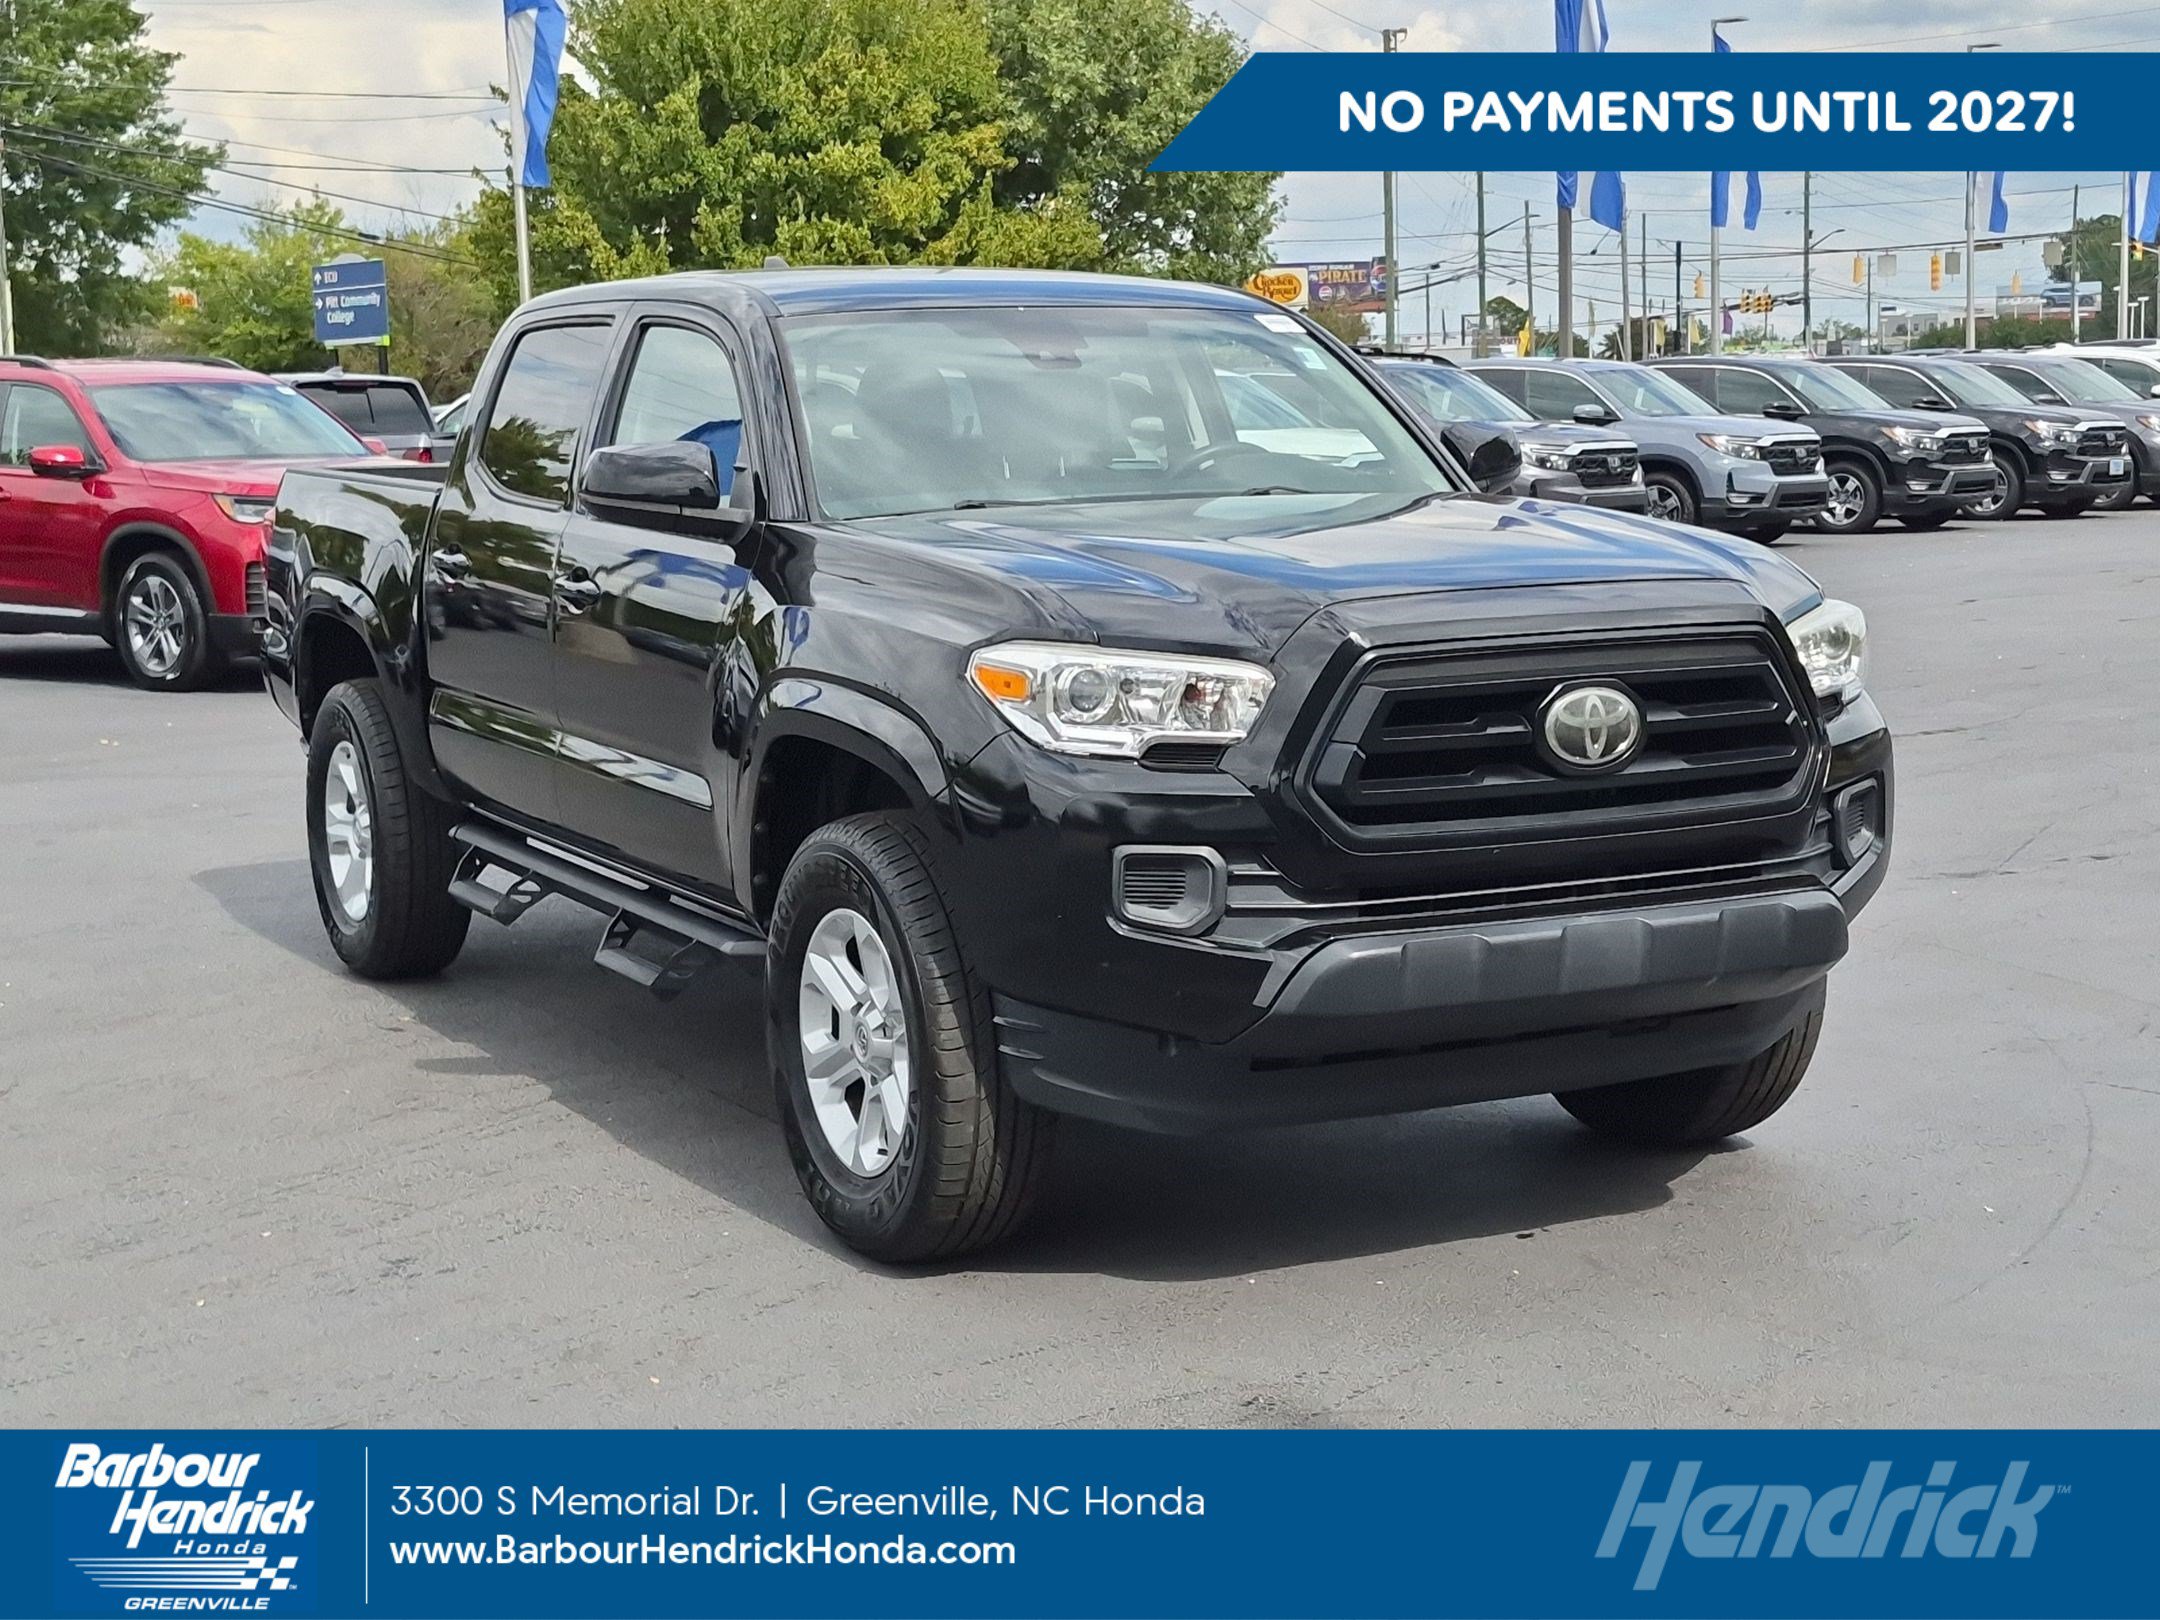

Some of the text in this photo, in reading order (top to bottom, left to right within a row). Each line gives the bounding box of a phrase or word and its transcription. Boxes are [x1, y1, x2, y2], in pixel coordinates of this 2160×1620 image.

[1318, 269, 1368, 284] PIRATE
[340, 292, 381, 308] Community
[327, 311, 355, 326] College
